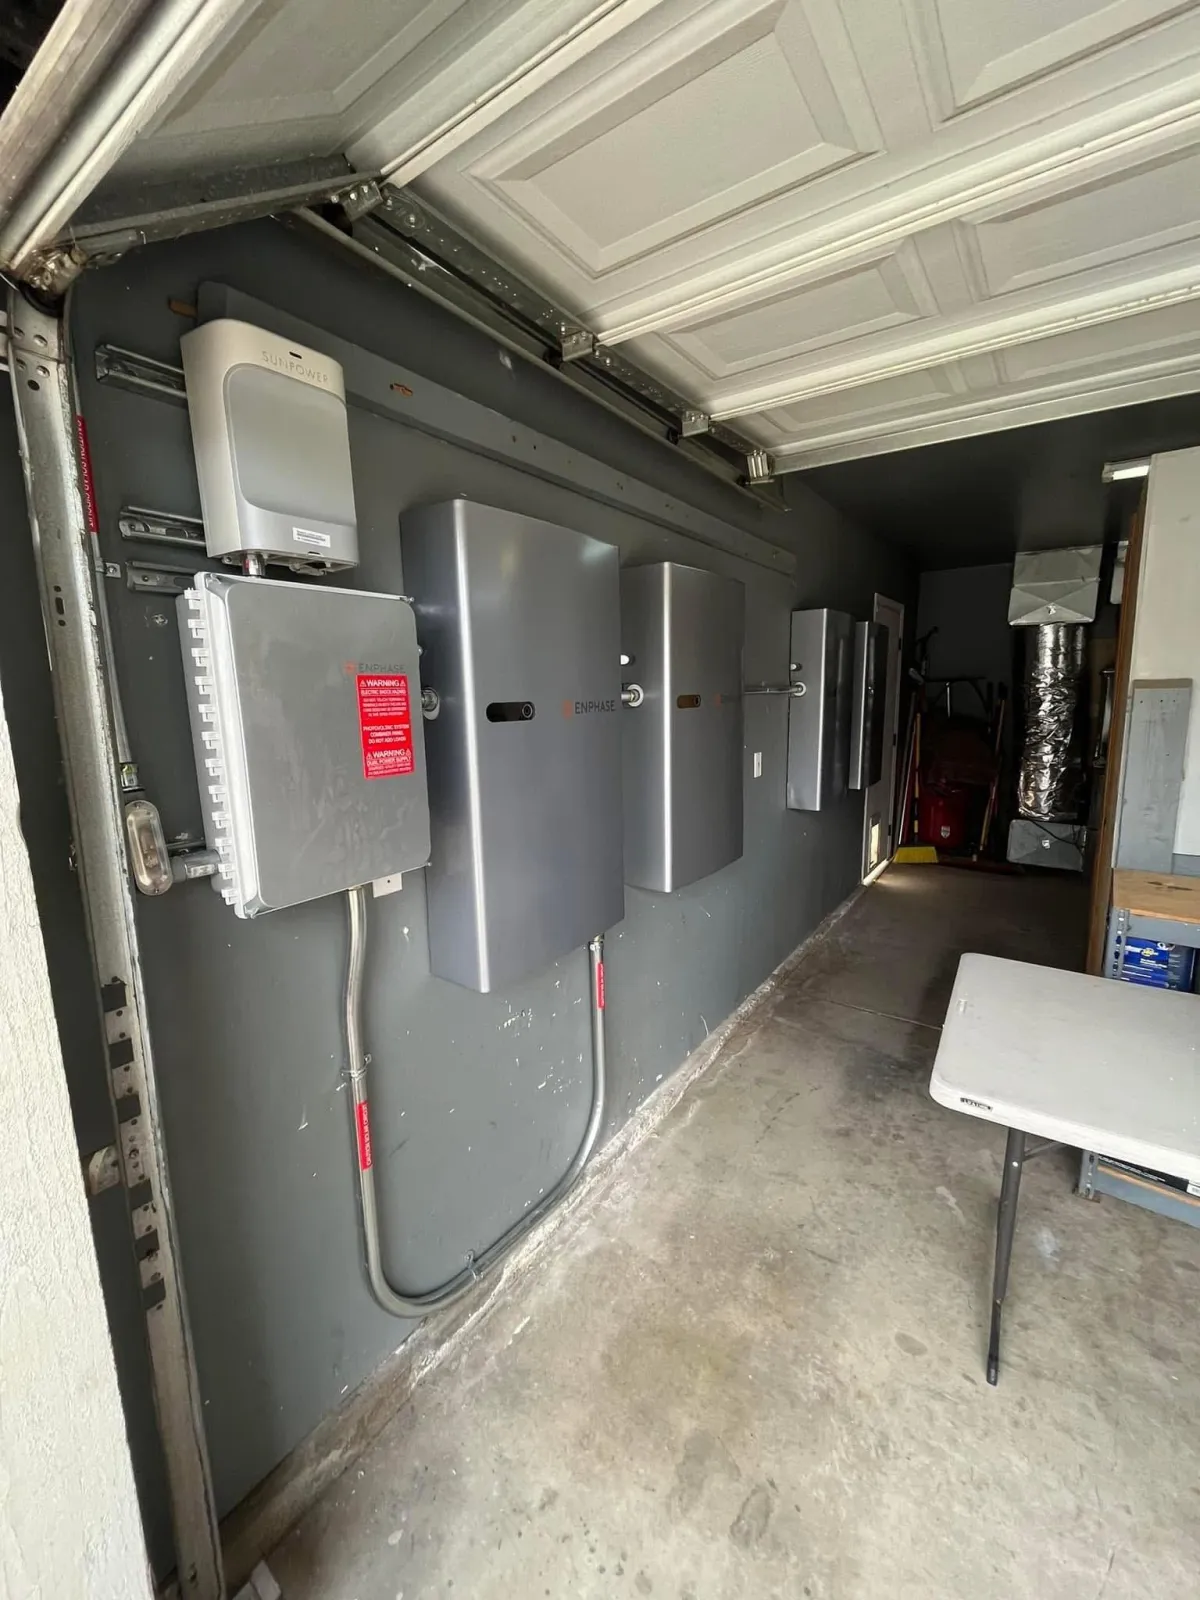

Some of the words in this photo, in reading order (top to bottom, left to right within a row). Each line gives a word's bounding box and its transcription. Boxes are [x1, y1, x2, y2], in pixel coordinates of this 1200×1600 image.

[262, 350, 328, 383] SUNPOWER
[359, 663, 406, 674] ENPHASE
[366, 679, 400, 687] WARNING
[574, 700, 616, 715] ENPHASE
[372, 749, 405, 758] WARNING
